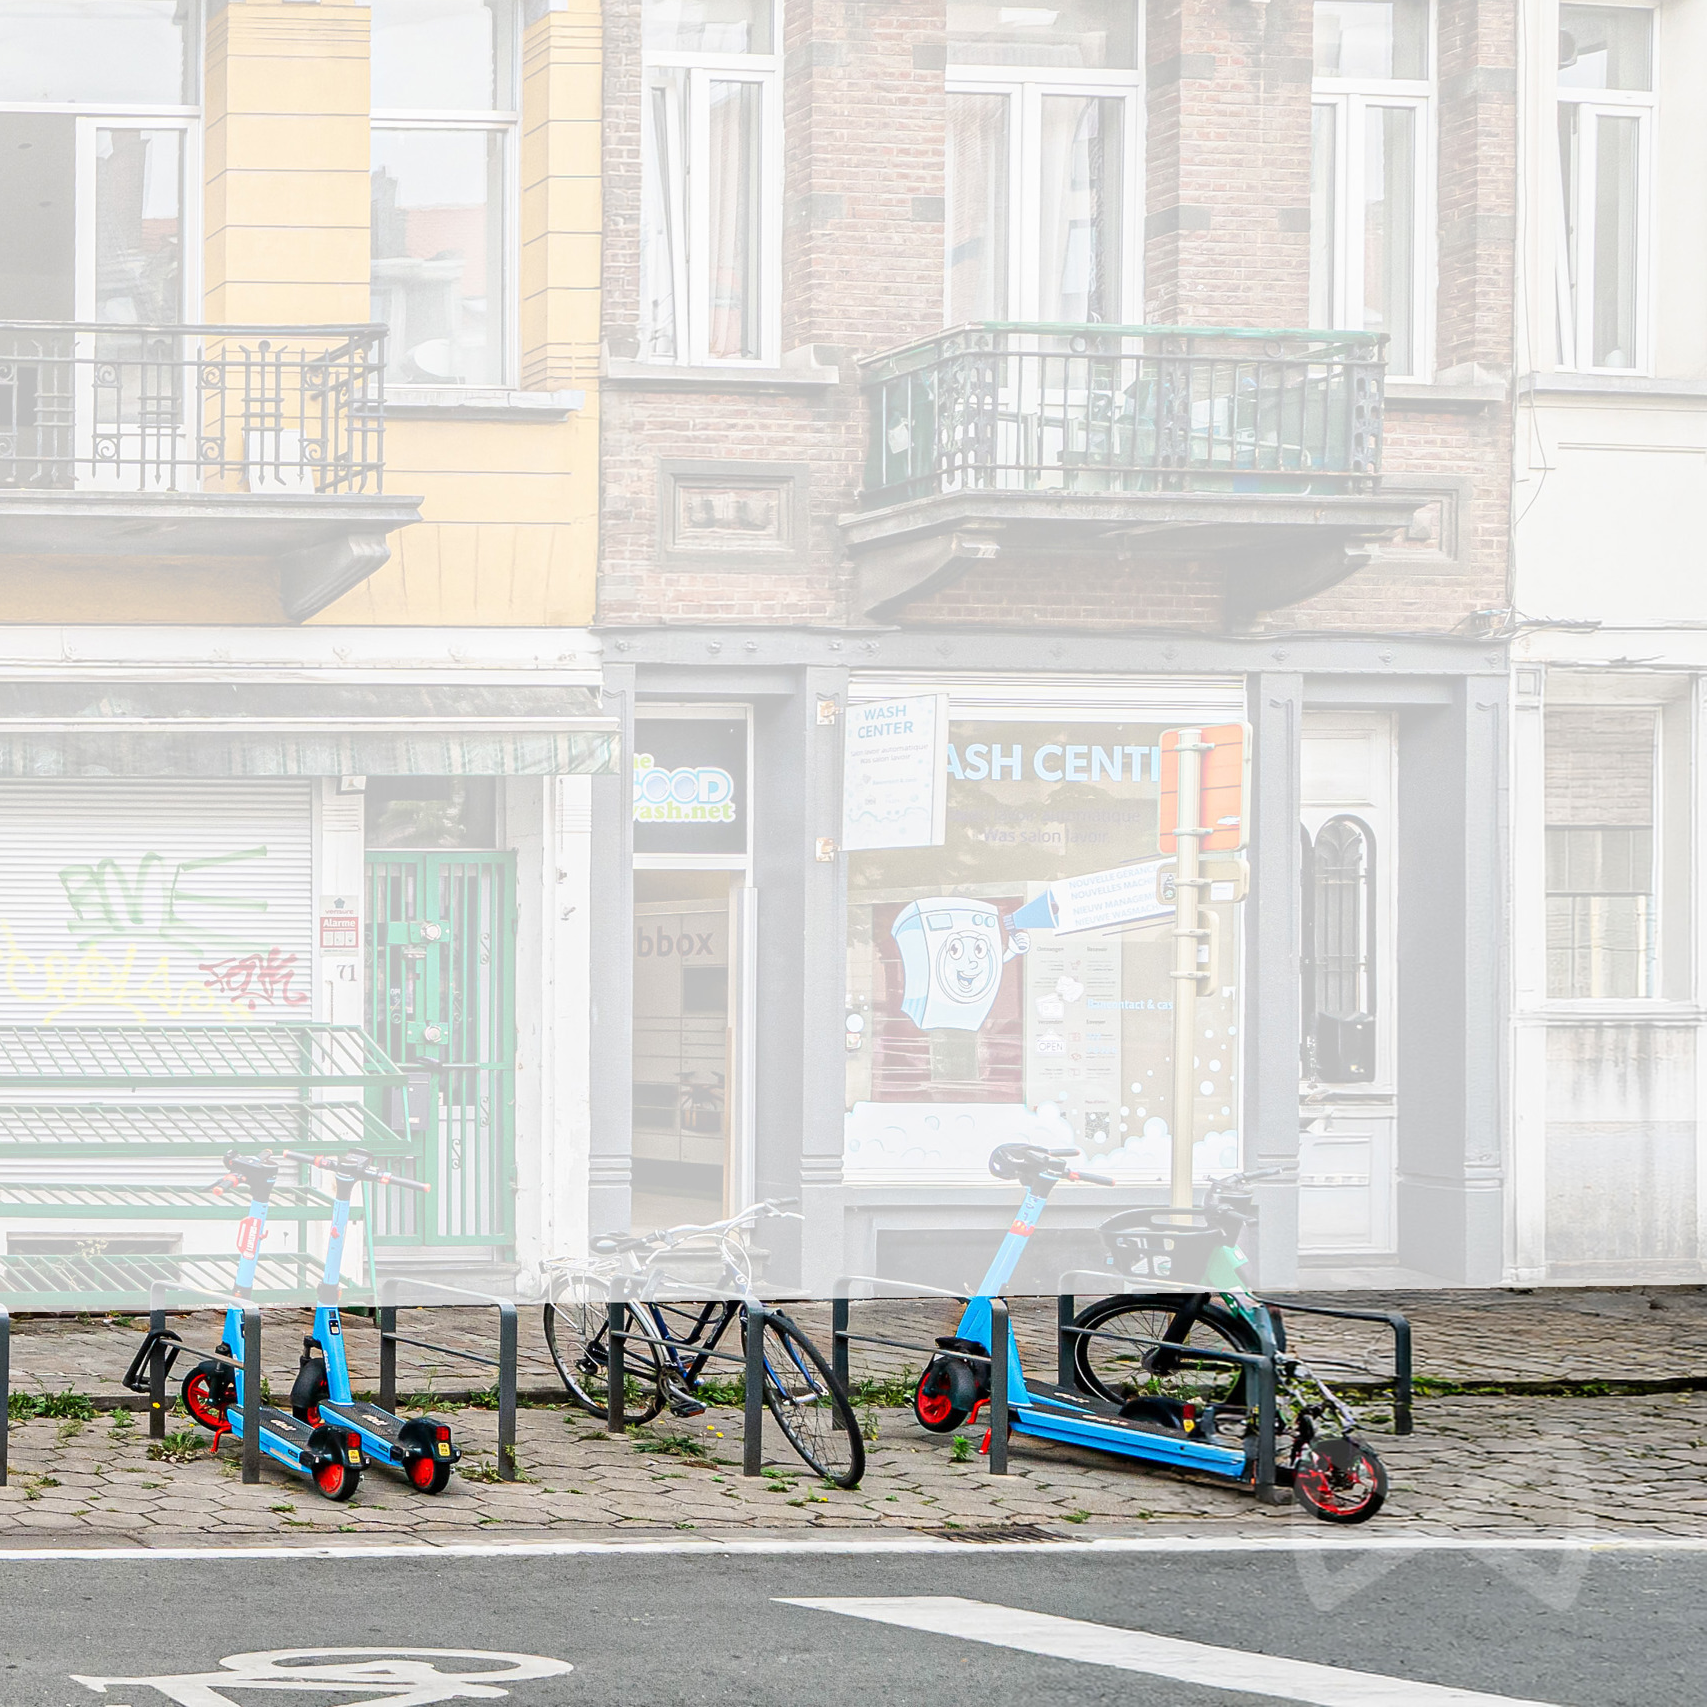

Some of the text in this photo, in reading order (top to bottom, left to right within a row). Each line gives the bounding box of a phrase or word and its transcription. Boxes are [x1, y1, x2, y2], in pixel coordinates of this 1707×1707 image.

[863, 704, 907, 721] WASH
[857, 720, 914, 739] CENTER
[947, 743, 1023, 781] ASH
[984, 827, 1110, 843] Was salon lavoir
[1068, 872, 1116, 889] NOUVELLE
[1071, 883, 1122, 900] NOUVELLES
[1073, 902, 1103, 916] NIEUW
[323, 918, 356, 927] Alarme
[1075, 912, 1111, 927] NIEUWE
[636, 925, 715, 958] bbox
[336, 964, 358, 982] 71
[1039, 1042, 1063, 1052] OPEN
